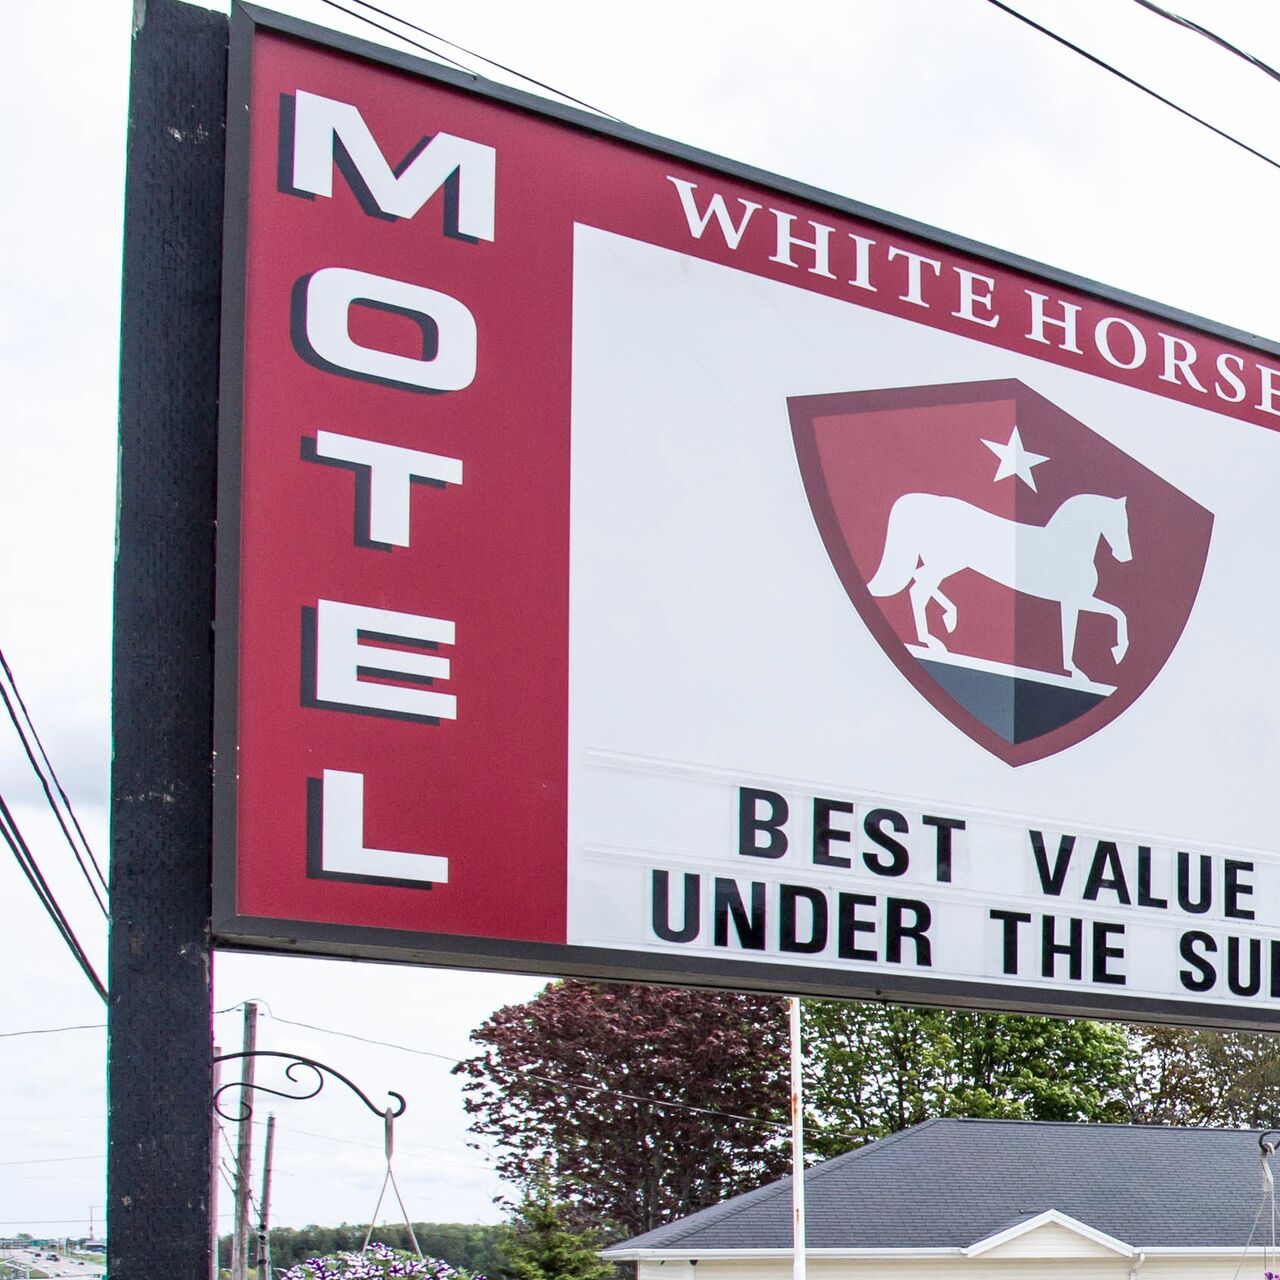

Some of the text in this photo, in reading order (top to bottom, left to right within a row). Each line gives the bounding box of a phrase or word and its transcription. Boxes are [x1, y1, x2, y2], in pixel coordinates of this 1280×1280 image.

[666, 174, 1000, 329] WHITE
[292, 88, 496, 886] MOTEL
[738, 785, 1256, 921] BEST VALUE
[650, 868, 933, 968] UNDER
[989, 908, 1128, 986] THE
